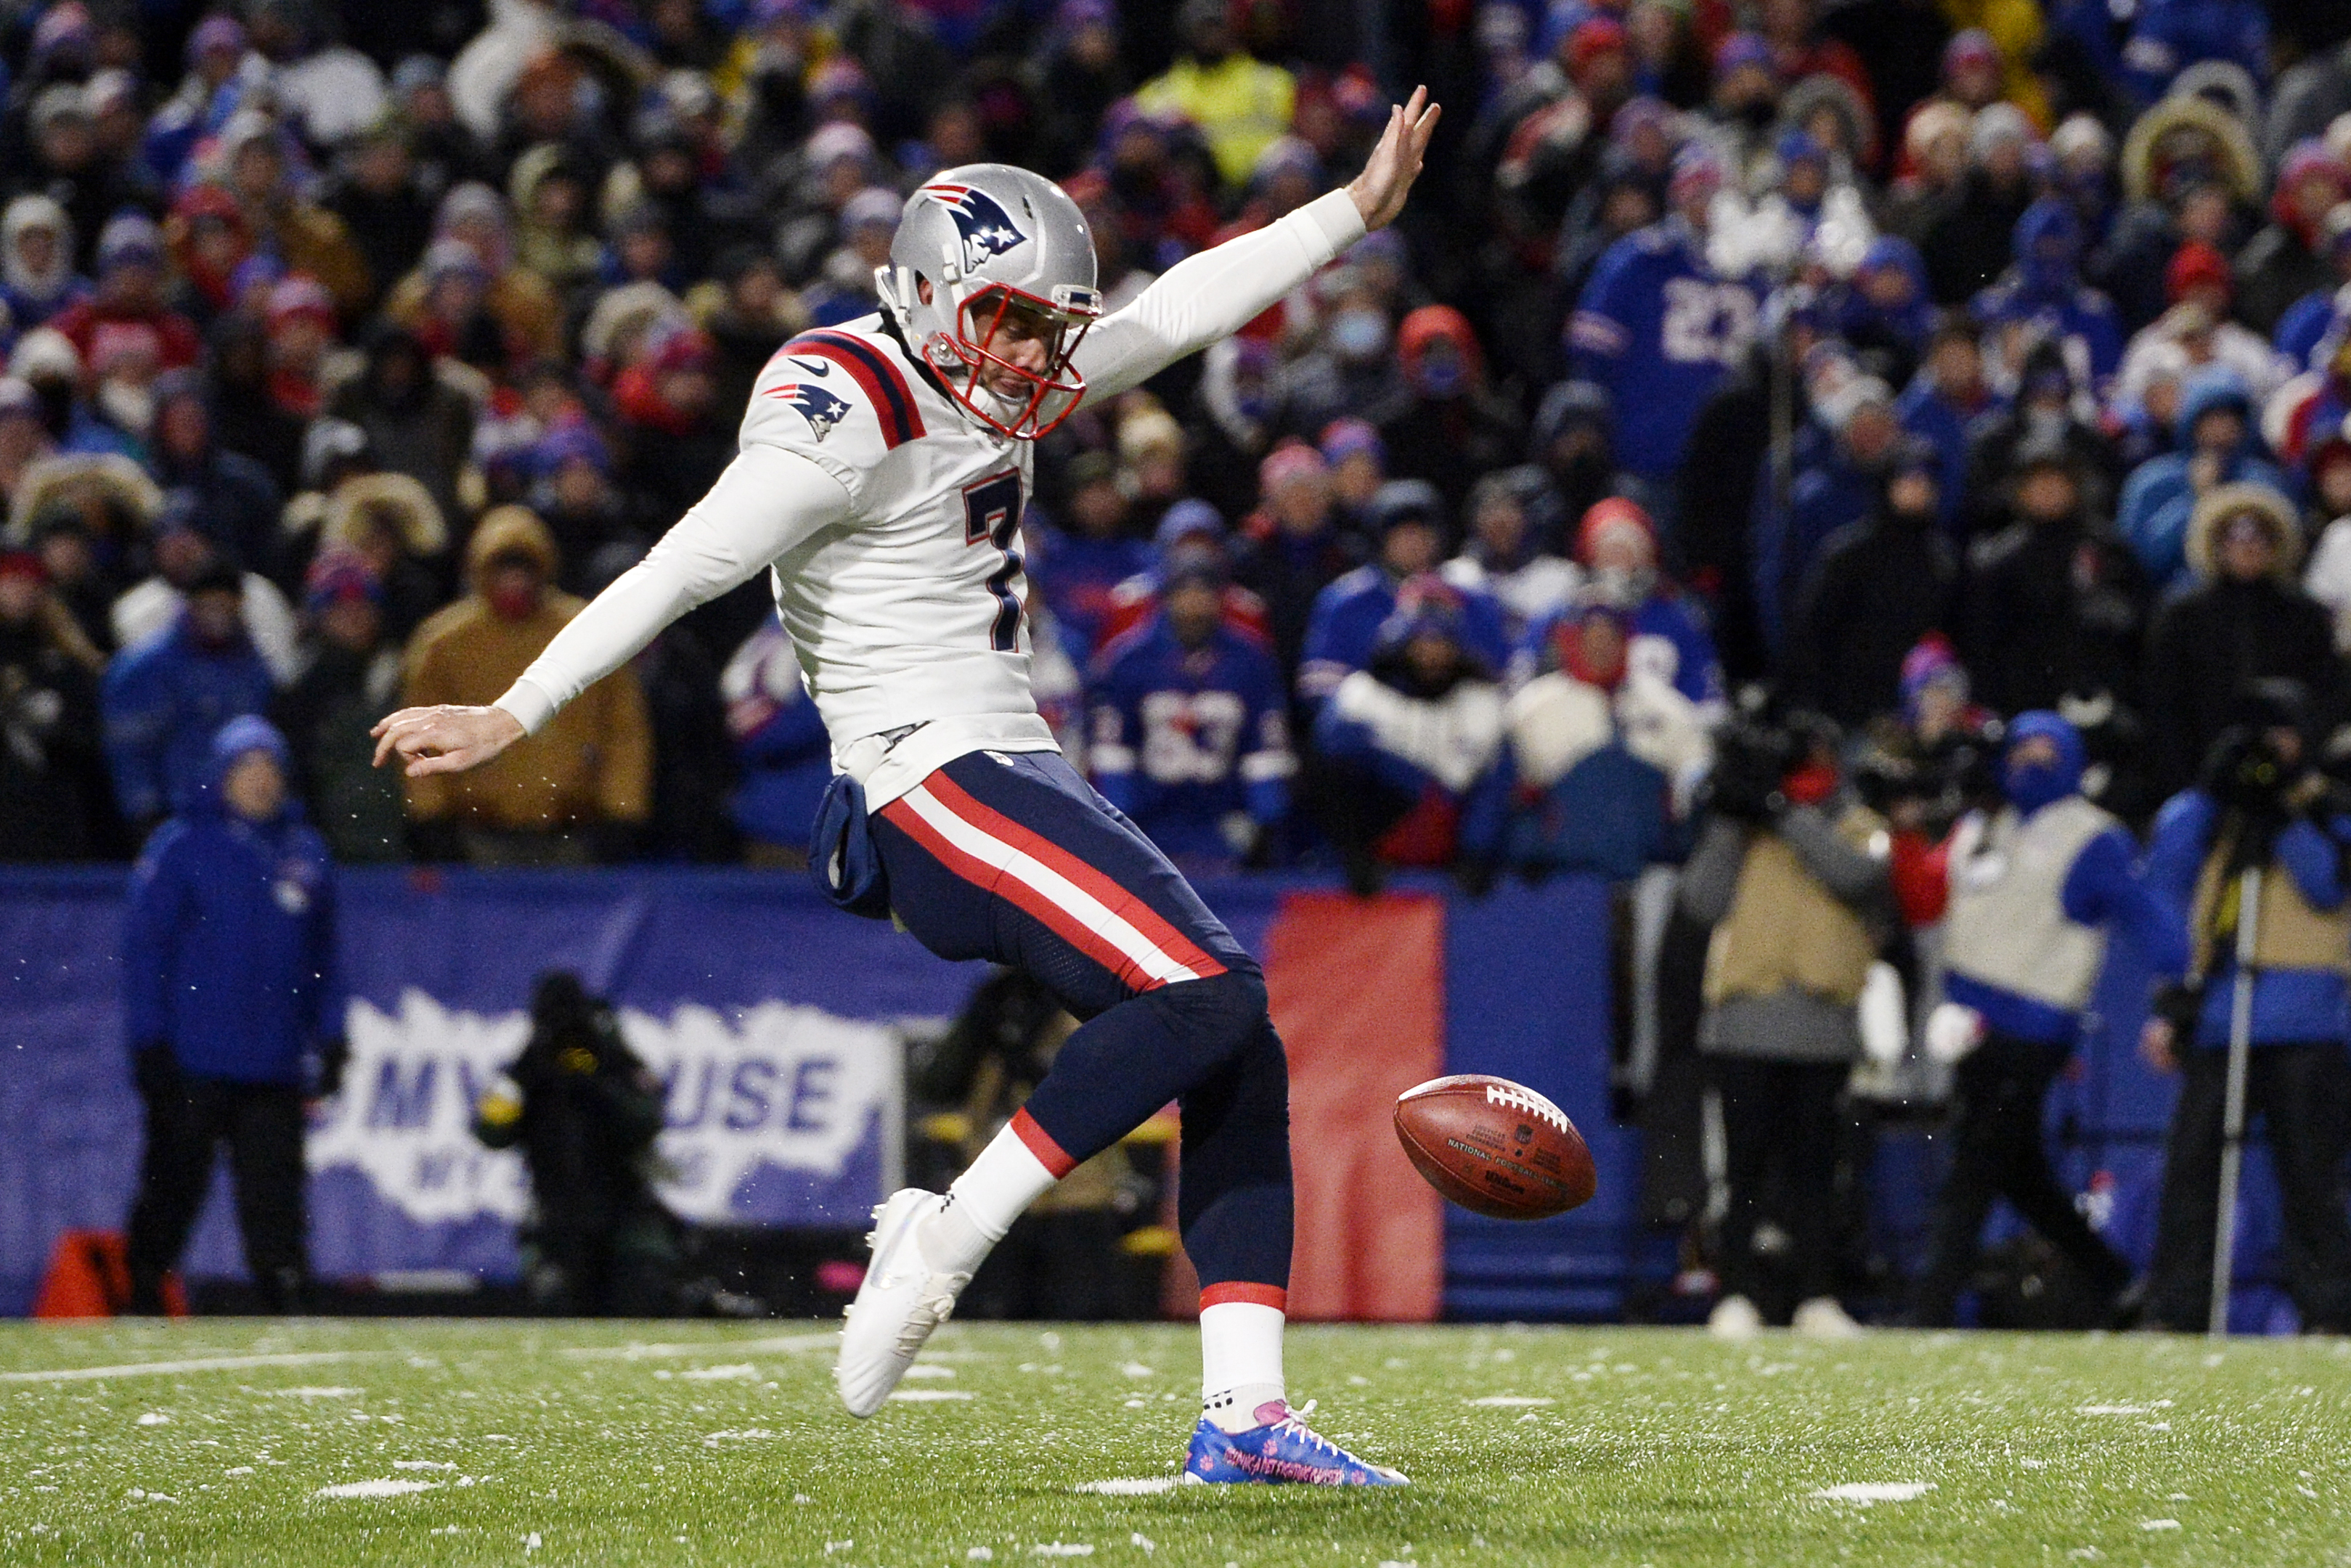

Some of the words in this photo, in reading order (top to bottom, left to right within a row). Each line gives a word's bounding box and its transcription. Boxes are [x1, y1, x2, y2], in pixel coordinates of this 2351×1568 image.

[961, 465, 1025, 653] 7
[662, 1057, 841, 1130] USE
[1448, 1138, 1492, 1161] NATIONAL
